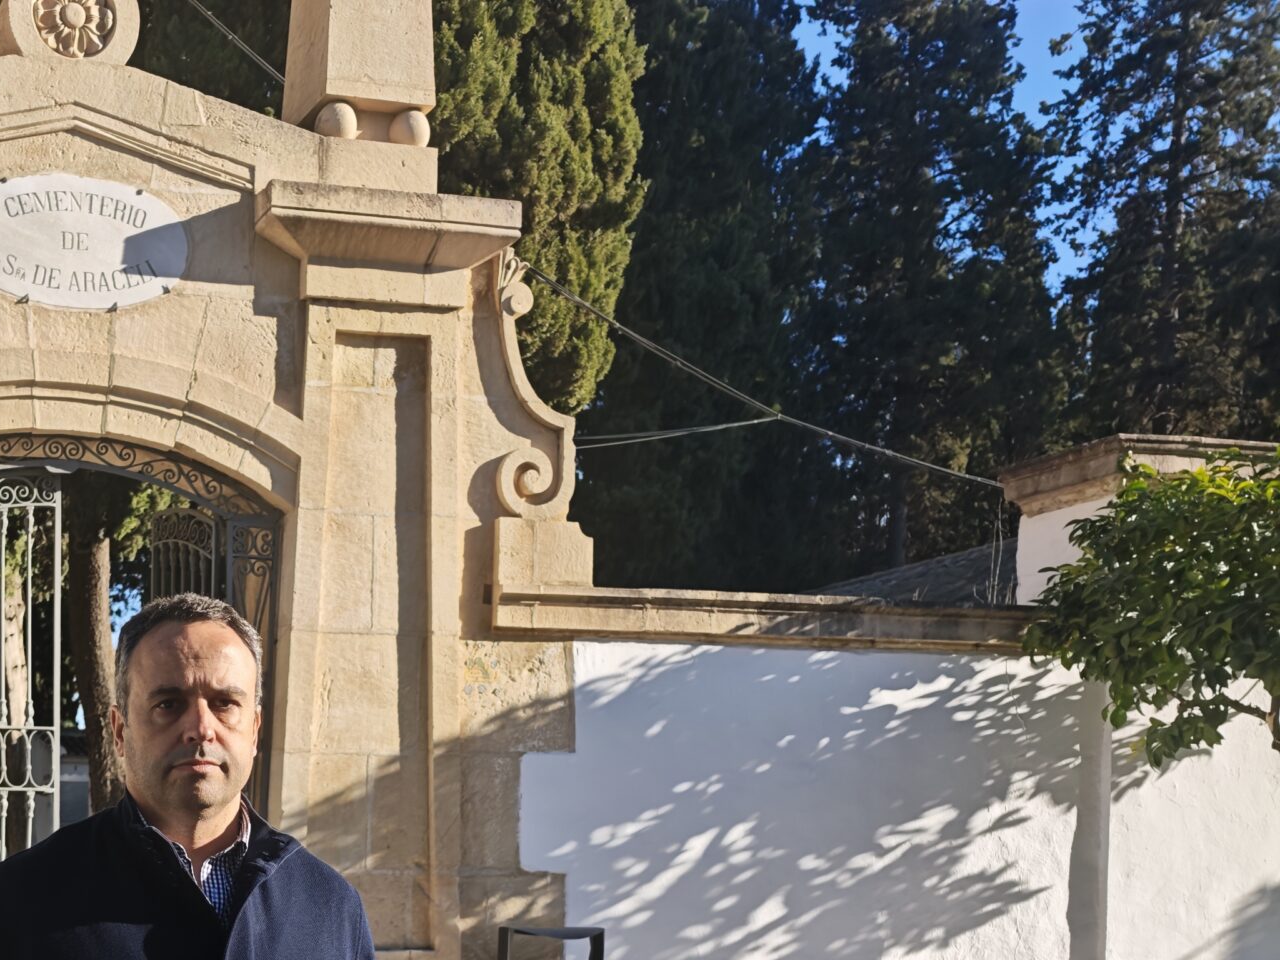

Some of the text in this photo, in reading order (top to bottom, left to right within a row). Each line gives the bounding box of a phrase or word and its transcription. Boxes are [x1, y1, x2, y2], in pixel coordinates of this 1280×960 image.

[4, 191, 147, 229] CEMENTERIO
[61, 231, 89, 251] DE
[32, 264, 61, 289] DE
[68, 260, 158, 292] ARACELI
